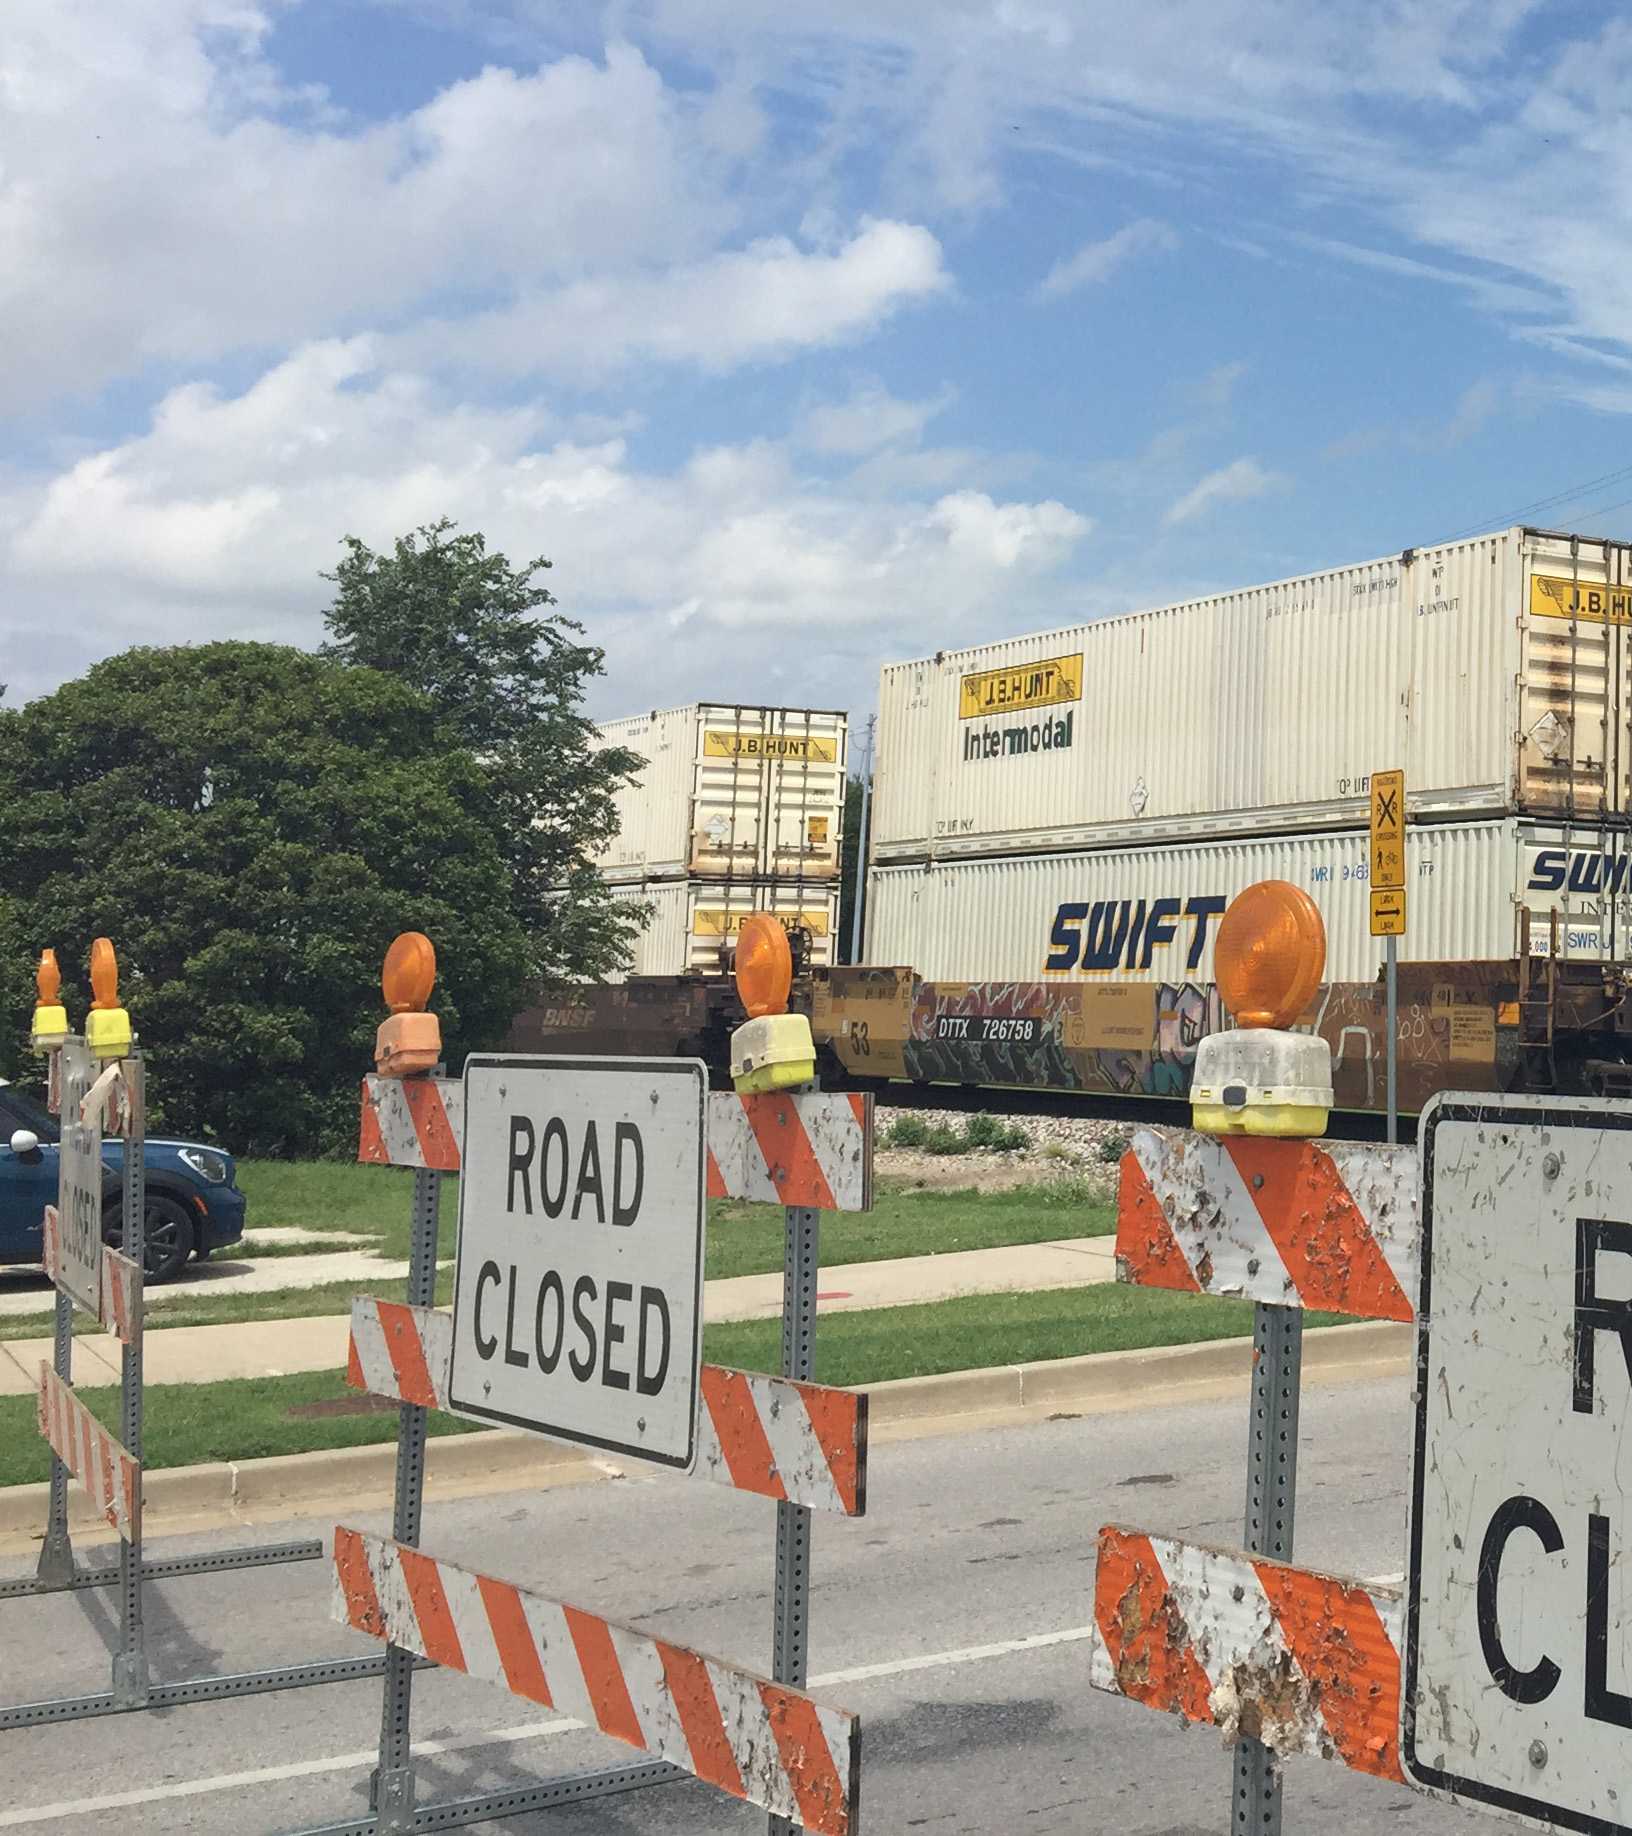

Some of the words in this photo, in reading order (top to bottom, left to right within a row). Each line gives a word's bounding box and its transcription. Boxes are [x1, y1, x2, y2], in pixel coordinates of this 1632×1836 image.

[963, 710, 1074, 762] Intermodal
[1043, 896, 1228, 973] SWIFT
[850, 1021, 870, 1057] 53
[938, 1018, 969, 1039] DTTX
[982, 1019, 1033, 1041] 726758
[506, 1115, 645, 1227] ROAD
[473, 1260, 671, 1396] CLOSED
